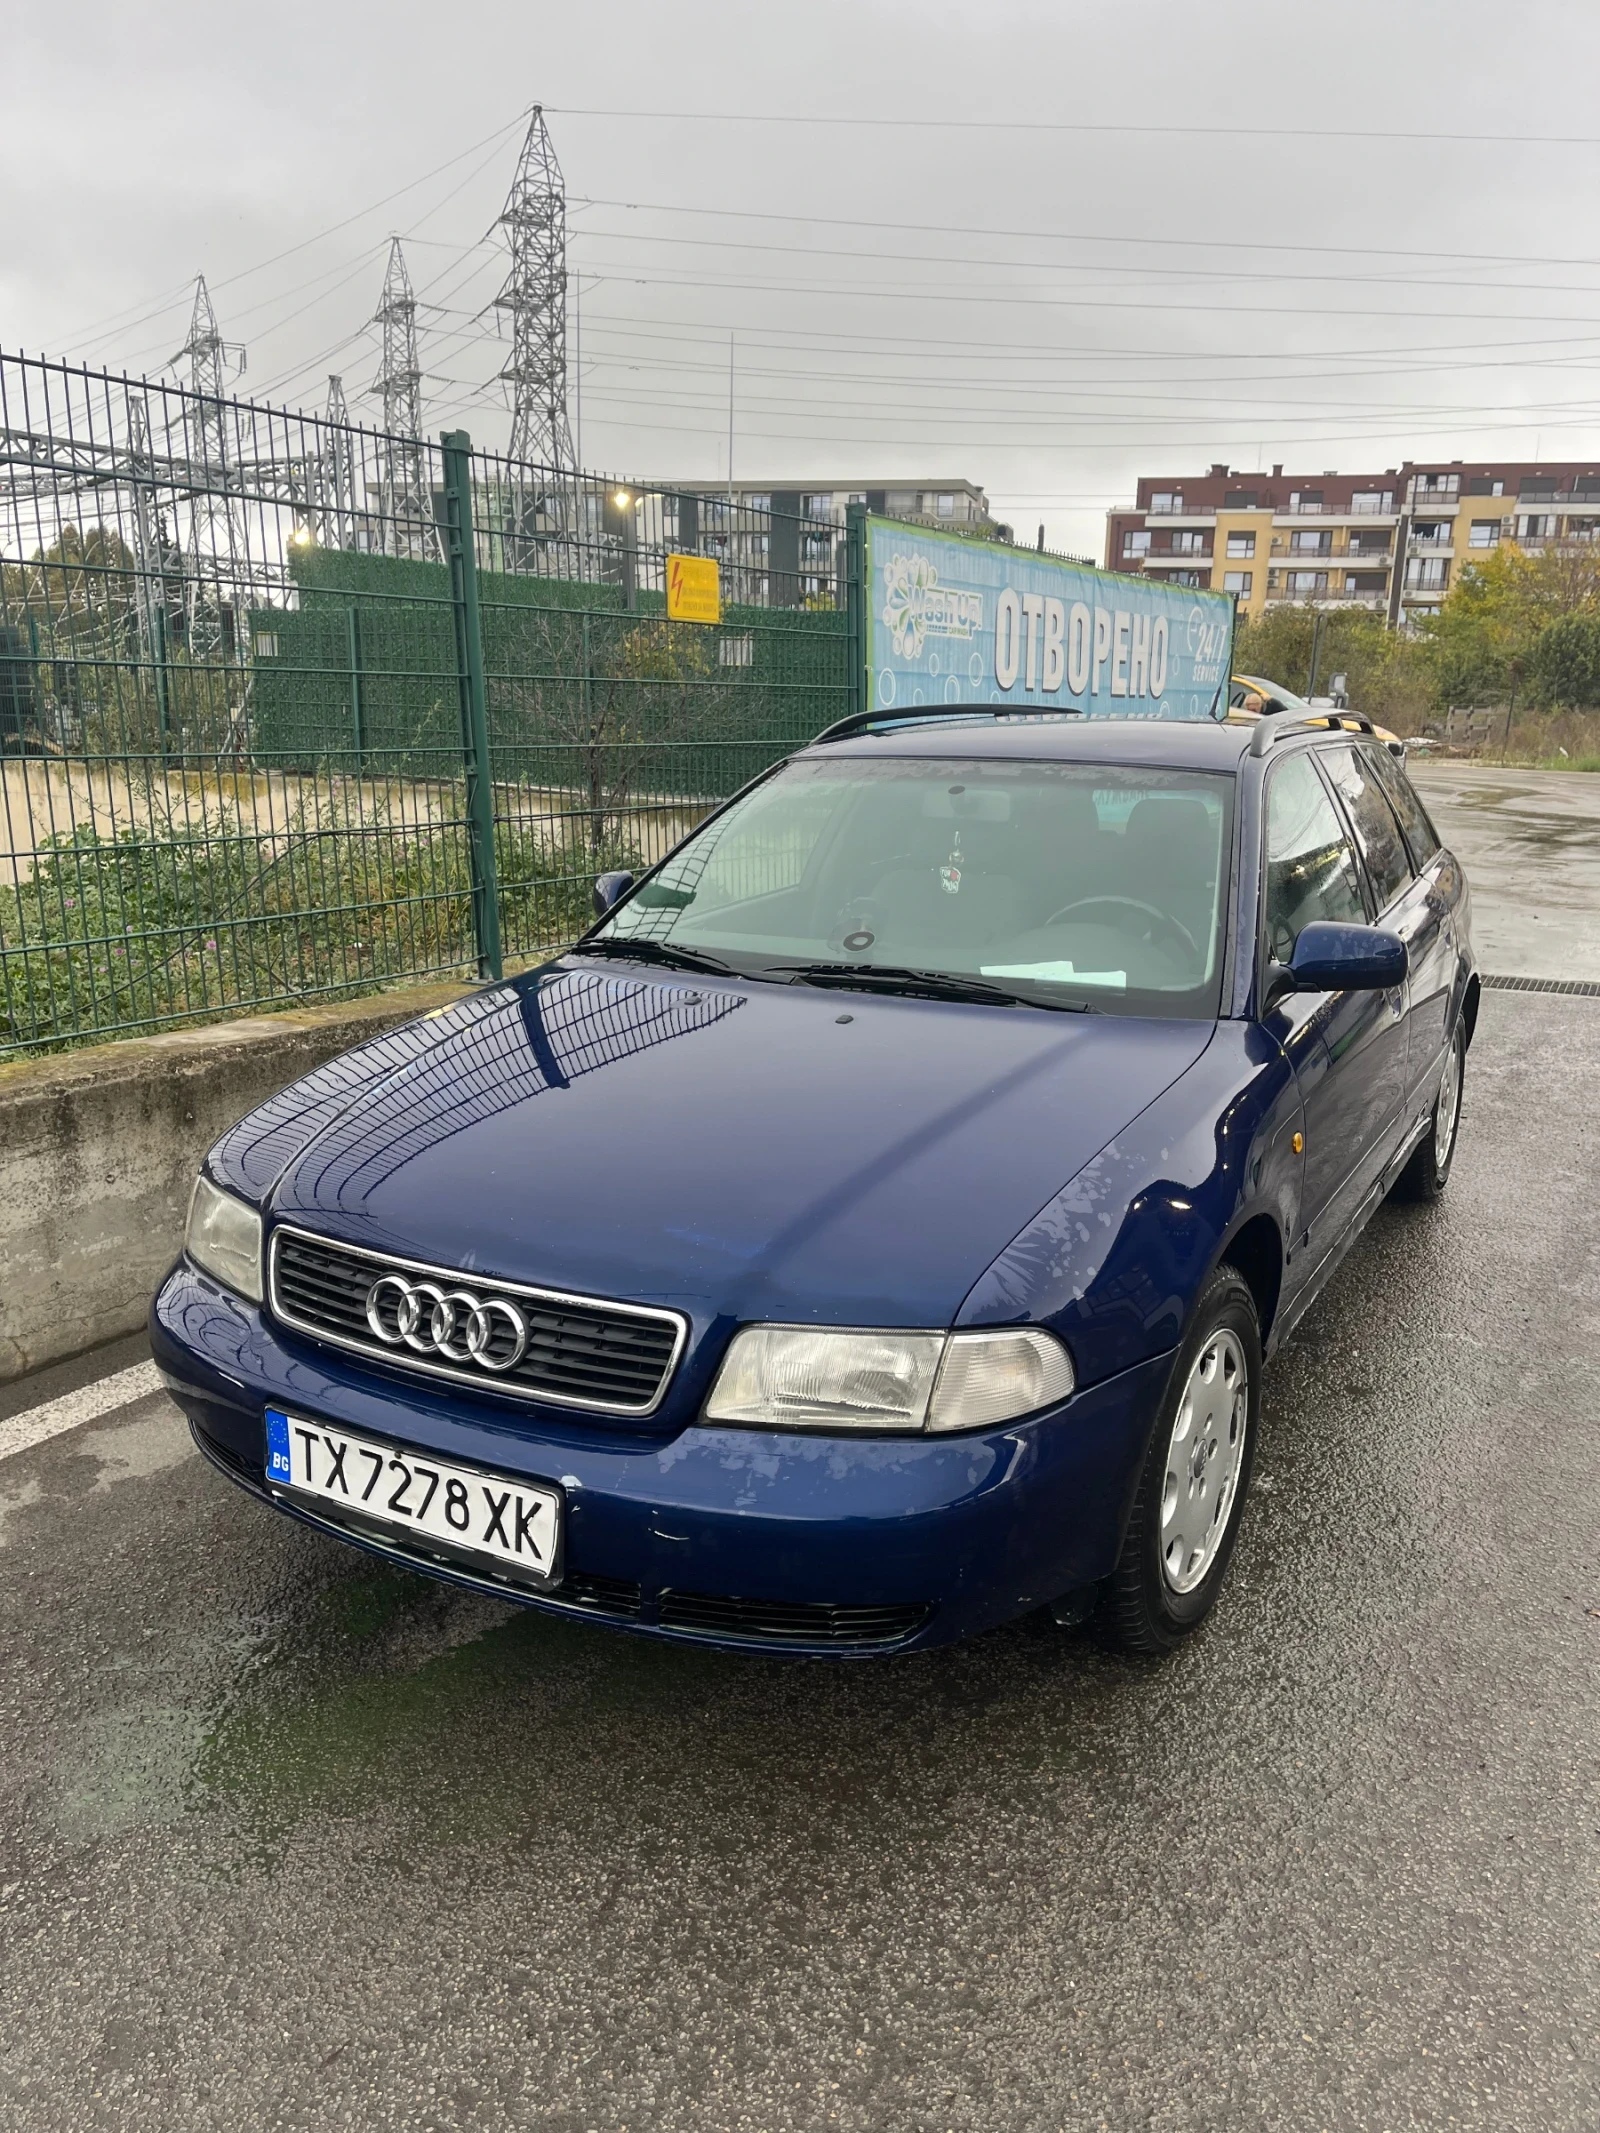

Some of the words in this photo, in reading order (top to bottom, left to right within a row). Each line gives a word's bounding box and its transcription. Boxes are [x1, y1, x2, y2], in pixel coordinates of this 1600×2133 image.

[995, 587, 1168, 699] ОТВОРЕНО
[1194, 622, 1227, 663] 24/7
[1193, 665, 1219, 682] SERVICE
[273, 1452, 289, 1472] BG
